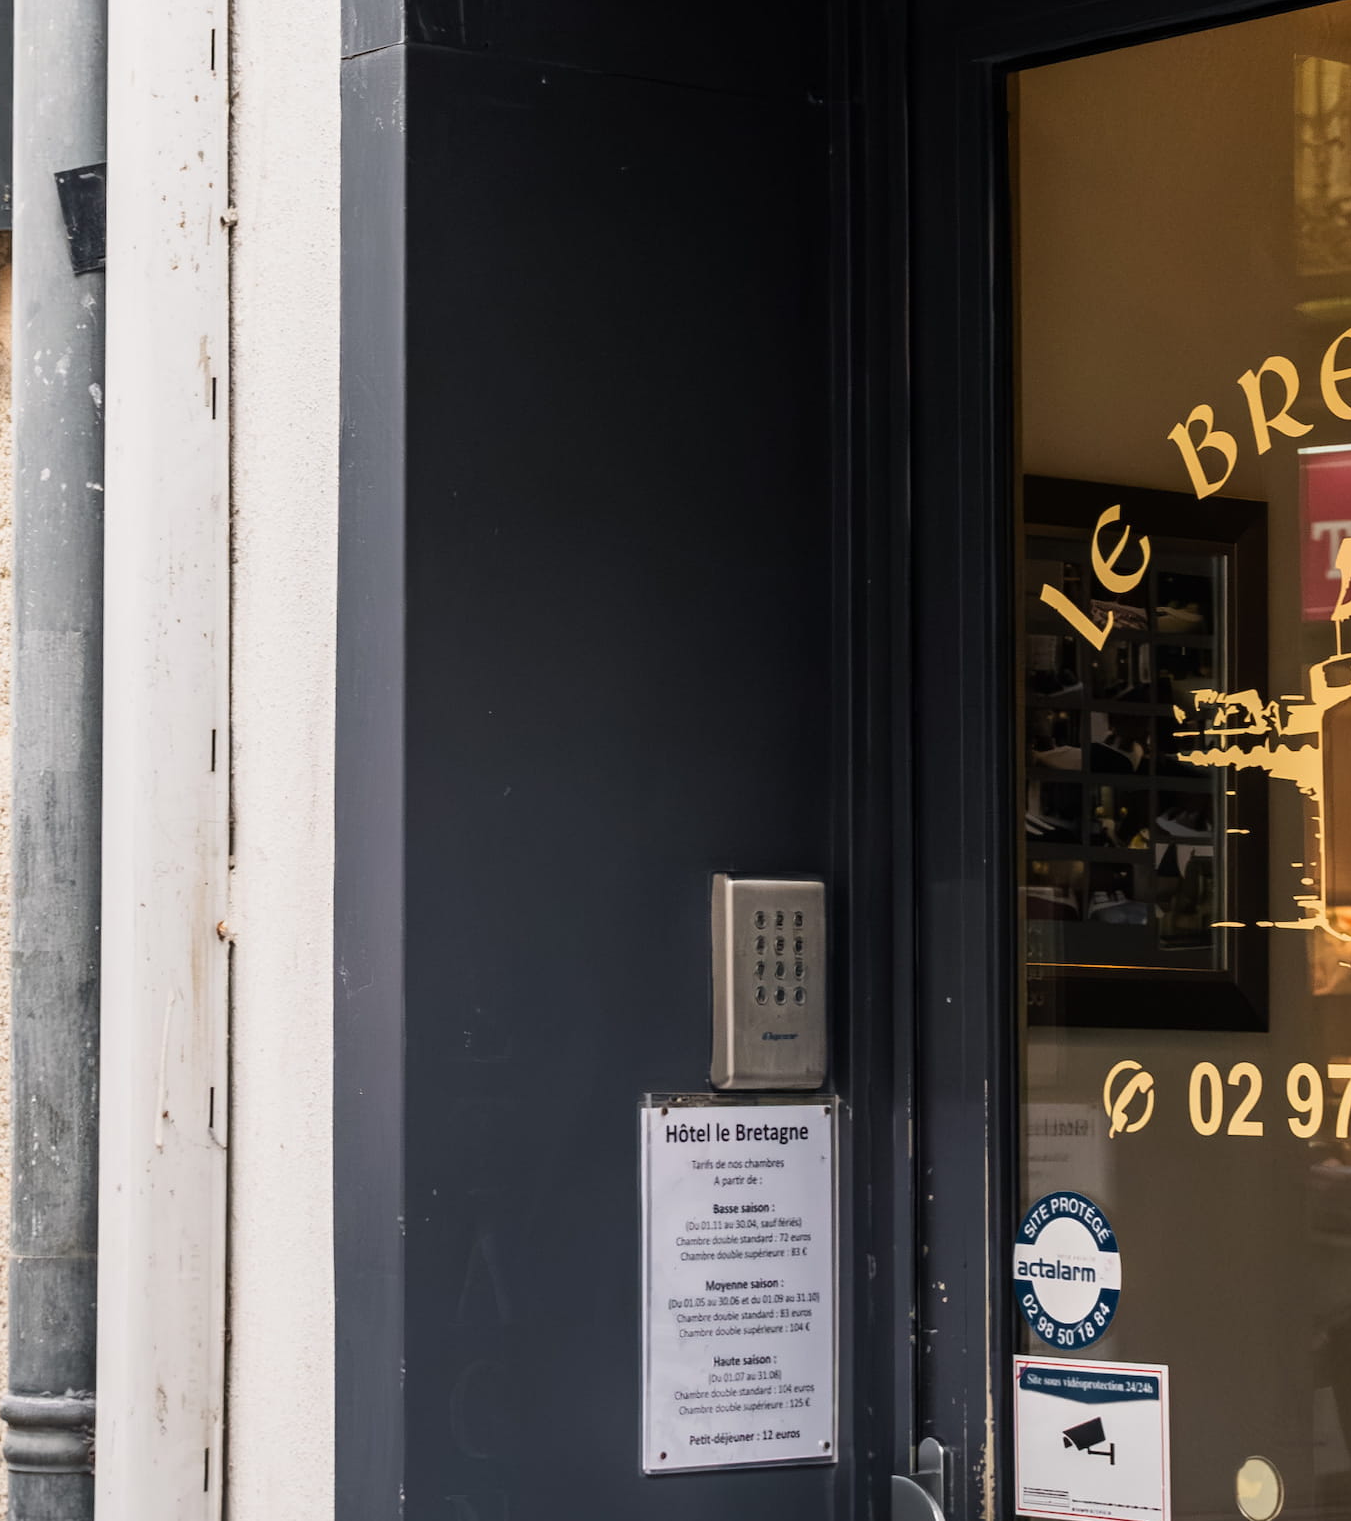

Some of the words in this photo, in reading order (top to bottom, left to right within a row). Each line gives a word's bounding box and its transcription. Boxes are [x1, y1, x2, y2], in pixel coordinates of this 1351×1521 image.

[1188, 1060, 1264, 1137] 02
[666, 1123, 710, 1143] Hôtel
[716, 1123, 730, 1142] le
[736, 1124, 809, 1145] Bretagne
[692, 1159, 714, 1170] Tarifs
[716, 1159, 726, 1169] de
[728, 1161, 743, 1169] nos
[744, 1158, 785, 1169] chambres
[713, 1176, 720, 1185] A
[722, 1175, 745, 1187] partir
[747, 1175, 758, 1184] de
[713, 1204, 739, 1214] Basse
[741, 1202, 770, 1213] saison
[1024, 1204, 1048, 1239] SITE
[1050, 1197, 1112, 1244] PROTÉGÉ
[676, 1236, 710, 1246] Chambre
[712, 1235, 739, 1245] double
[740, 1234, 773, 1244] standard
[790, 1233, 812, 1242] euros
[680, 1251, 715, 1261] Chambre
[717, 1249, 743, 1260] double
[1017, 1258, 1096, 1283] actalarm
[705, 1280, 748, 1293] Moyenne
[750, 1277, 779, 1289] saison
[677, 1313, 711, 1323] Chambre
[713, 1311, 739, 1321] double
[741, 1310, 774, 1320] standard
[791, 1309, 813, 1318] euros
[1022, 1293, 1039, 1319] 02
[1037, 1316, 1055, 1339] 98
[1057, 1328, 1075, 1346] 50
[1093, 1302, 1110, 1327] 84
[679, 1328, 713, 1338] Chambre
[715, 1326, 741, 1336] double
[713, 1356, 741, 1367] Haute
[743, 1354, 771, 1365] saison
[674, 1389, 709, 1400] Chambre
[711, 1388, 737, 1398] double
[739, 1385, 772, 1396] standard
[794, 1383, 815, 1393] euros
[679, 1405, 713, 1415] Chambre
[715, 1402, 741, 1413] double
[689, 1431, 755, 1446] Petit-déjeuner
[763, 1430, 774, 1441] 12
[776, 1430, 801, 1440] euros
